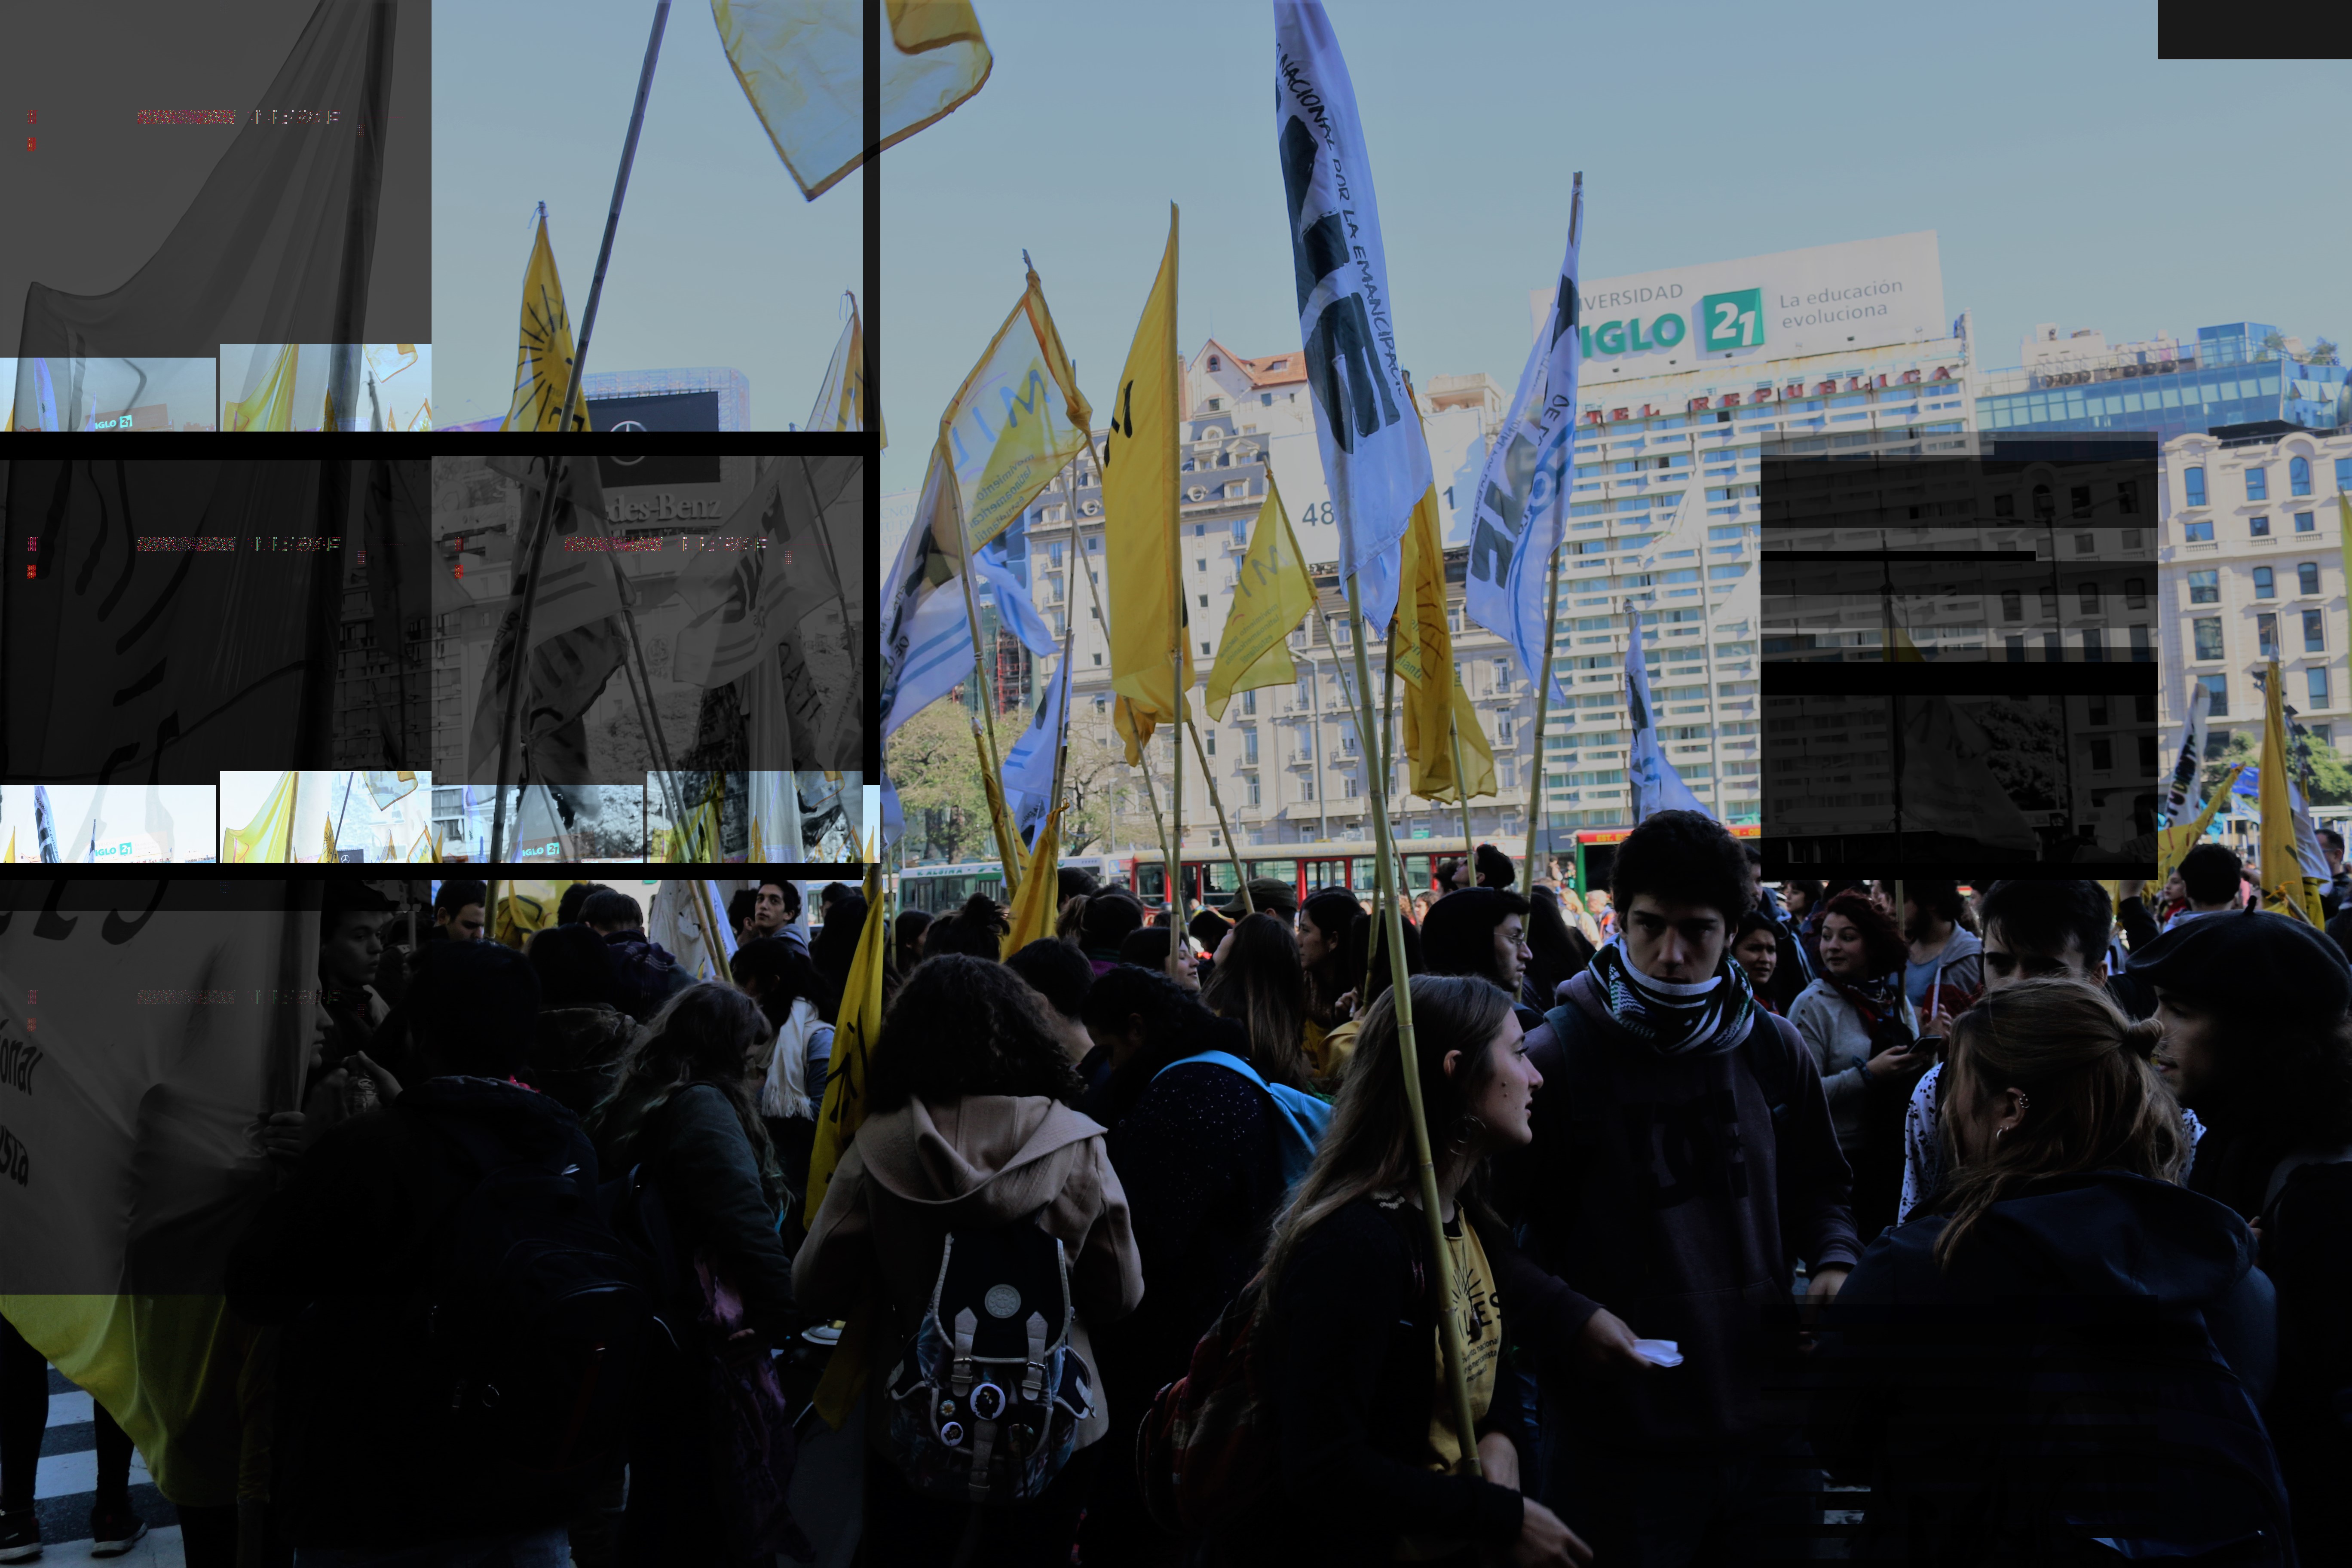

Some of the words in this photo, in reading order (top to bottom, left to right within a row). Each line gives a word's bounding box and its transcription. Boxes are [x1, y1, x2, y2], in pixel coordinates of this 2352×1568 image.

[1280, 53, 1335, 151] NACIONAL
[1333, 158, 1350, 202] POR
[1343, 209, 1359, 239] LA
[1353, 245, 1402, 398] EMANCIPAC
[1578, 284, 1683, 312] IVERSIDAD
[1780, 294, 1800, 309] La
[1807, 279, 1903, 304] educación
[1580, 312, 1686, 358] IGLO
[1712, 302, 1756, 346] 21
[1782, 303, 1888, 328] evoluciona
[1586, 403, 1660, 424] TEL
[1692, 366, 1951, 411] REPUBLICA
[605, 493, 723, 524] des-Benz
